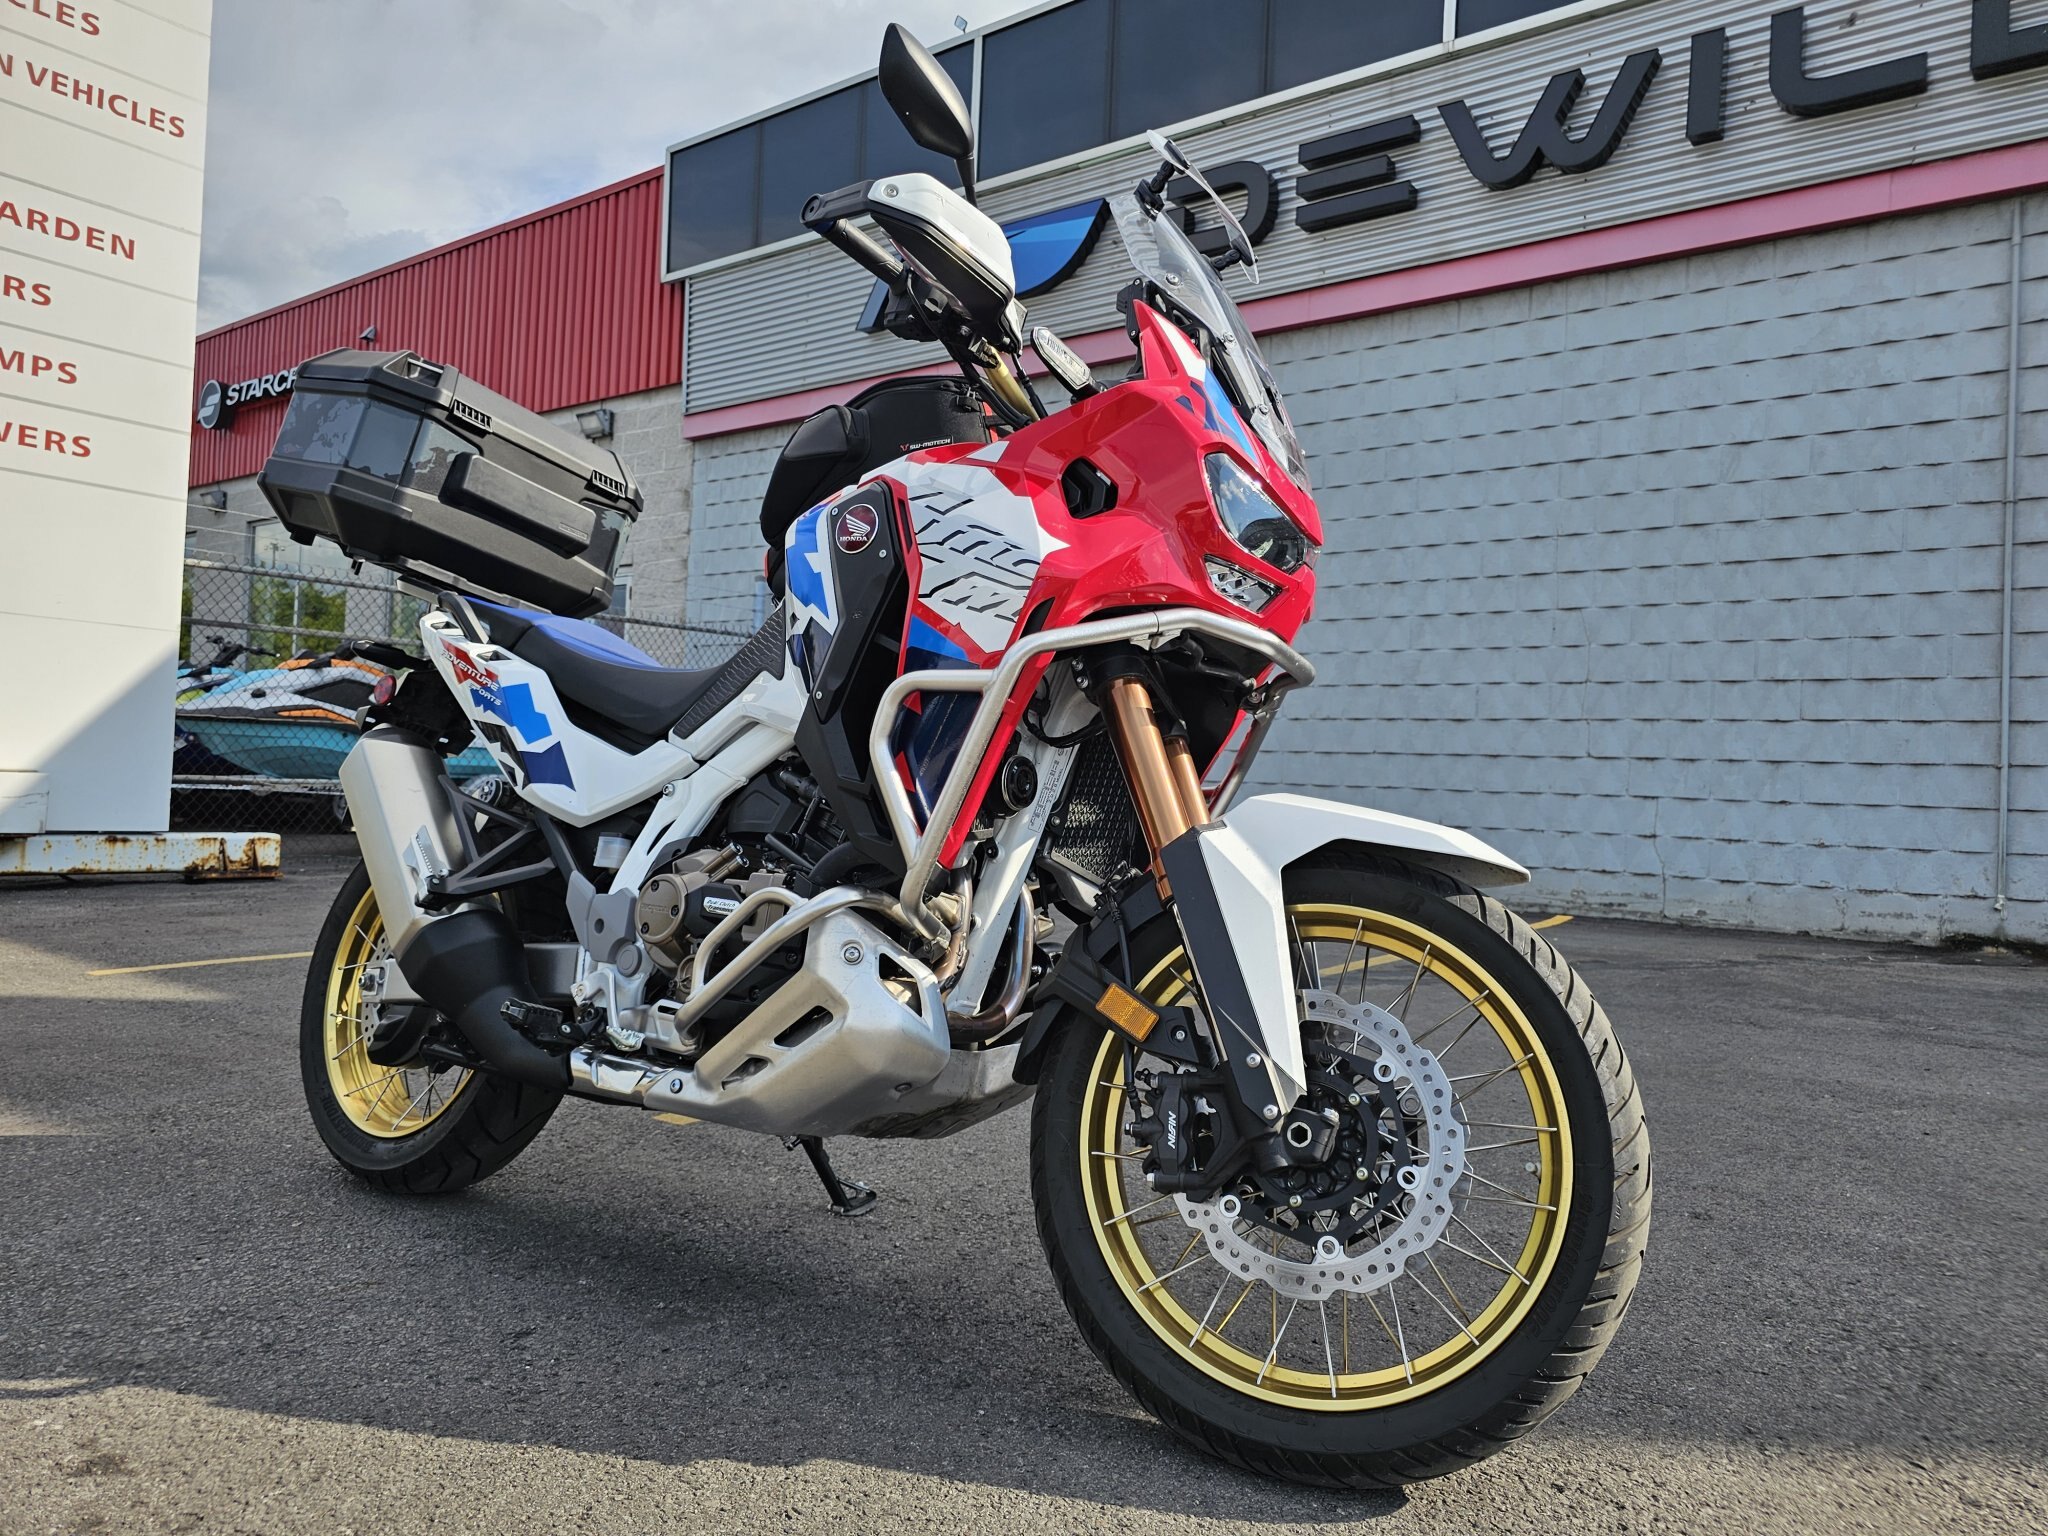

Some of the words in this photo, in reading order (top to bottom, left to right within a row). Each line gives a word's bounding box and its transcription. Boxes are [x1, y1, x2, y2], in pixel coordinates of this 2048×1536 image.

[25, 60, 185, 138] VEHICLES
[0, 200, 135, 260] ARDEN
[2, 274, 52, 306] RS
[909, 438, 951, 449] SW-MOTECH
[441, 650, 500, 691] ADVENTURE
[469, 682, 503, 706] SPORTS
[1167, 1110, 1177, 1150] NISSIN
